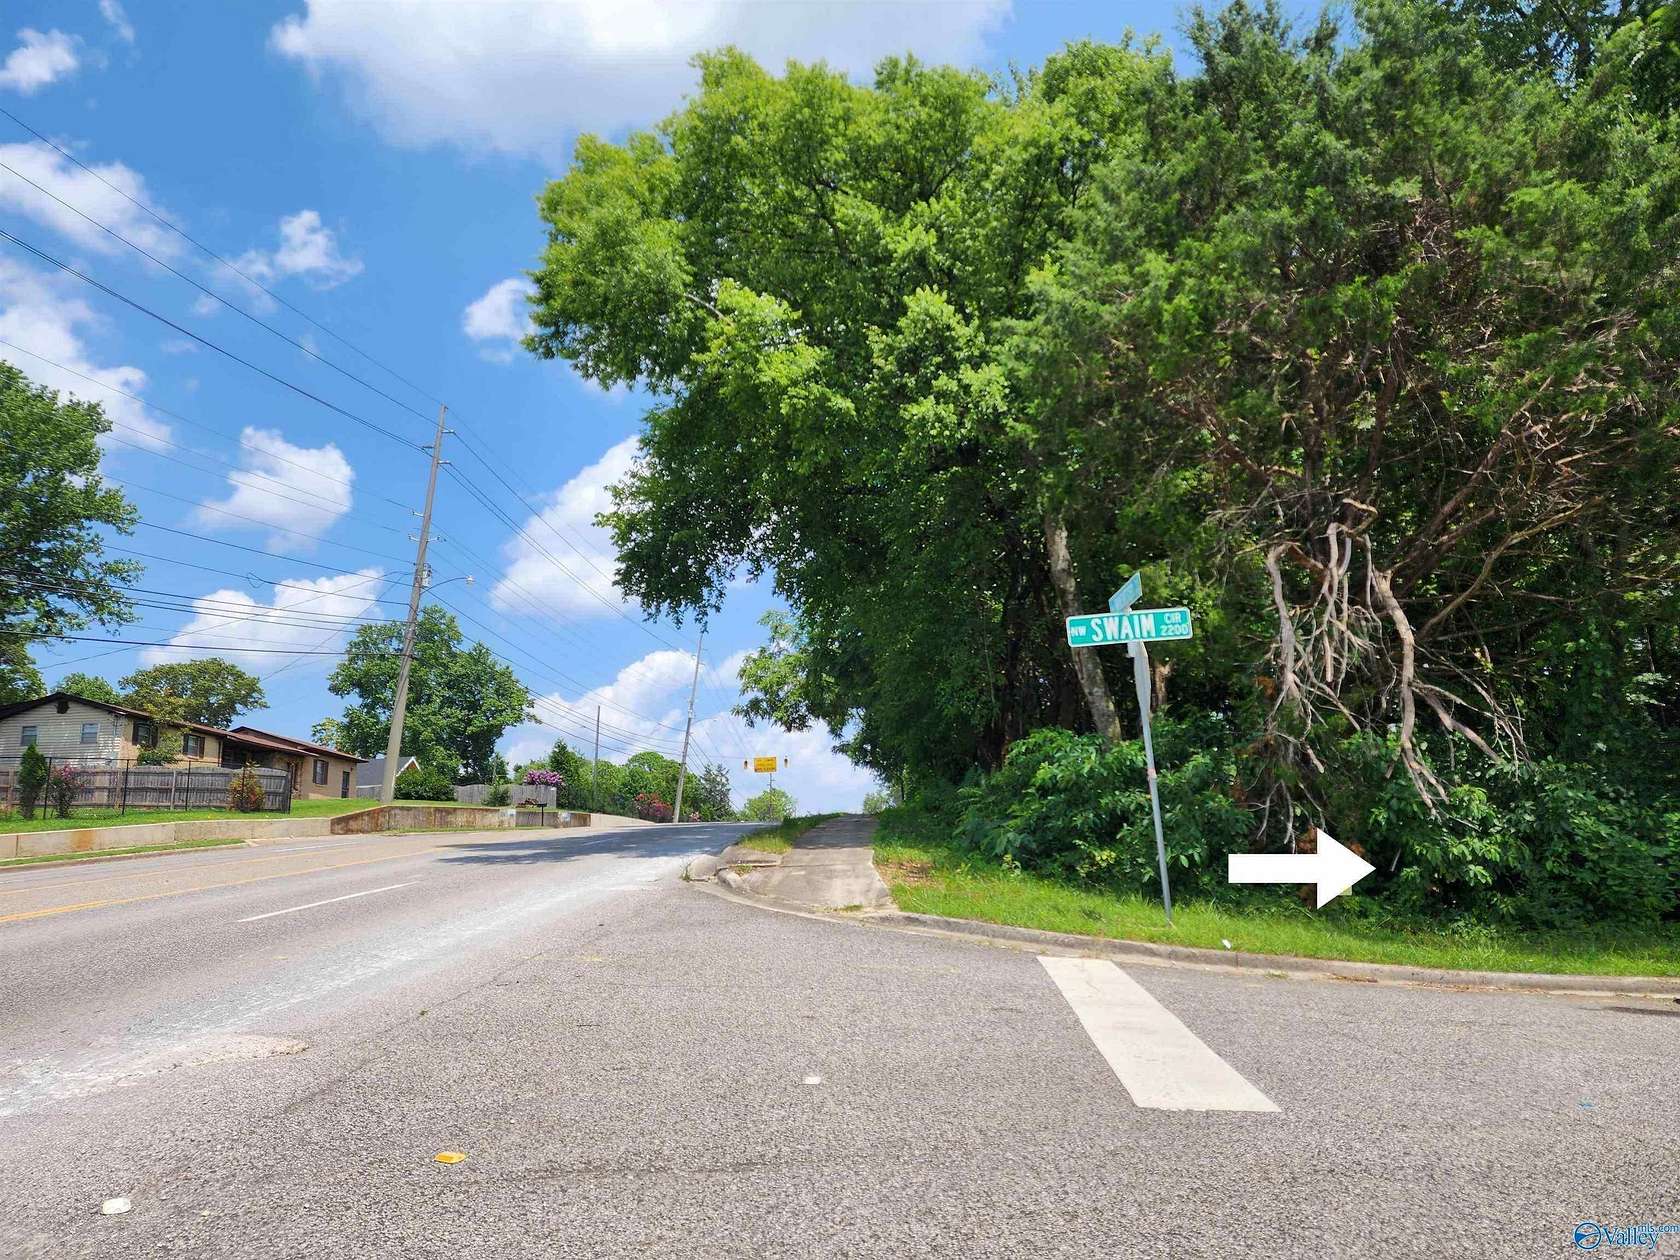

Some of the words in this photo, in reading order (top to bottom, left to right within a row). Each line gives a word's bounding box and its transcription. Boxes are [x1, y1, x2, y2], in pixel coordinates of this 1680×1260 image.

[1070, 626, 1087, 637] NW
[1090, 613, 1156, 641] SWAIM
[1164, 612, 1182, 624] CIR
